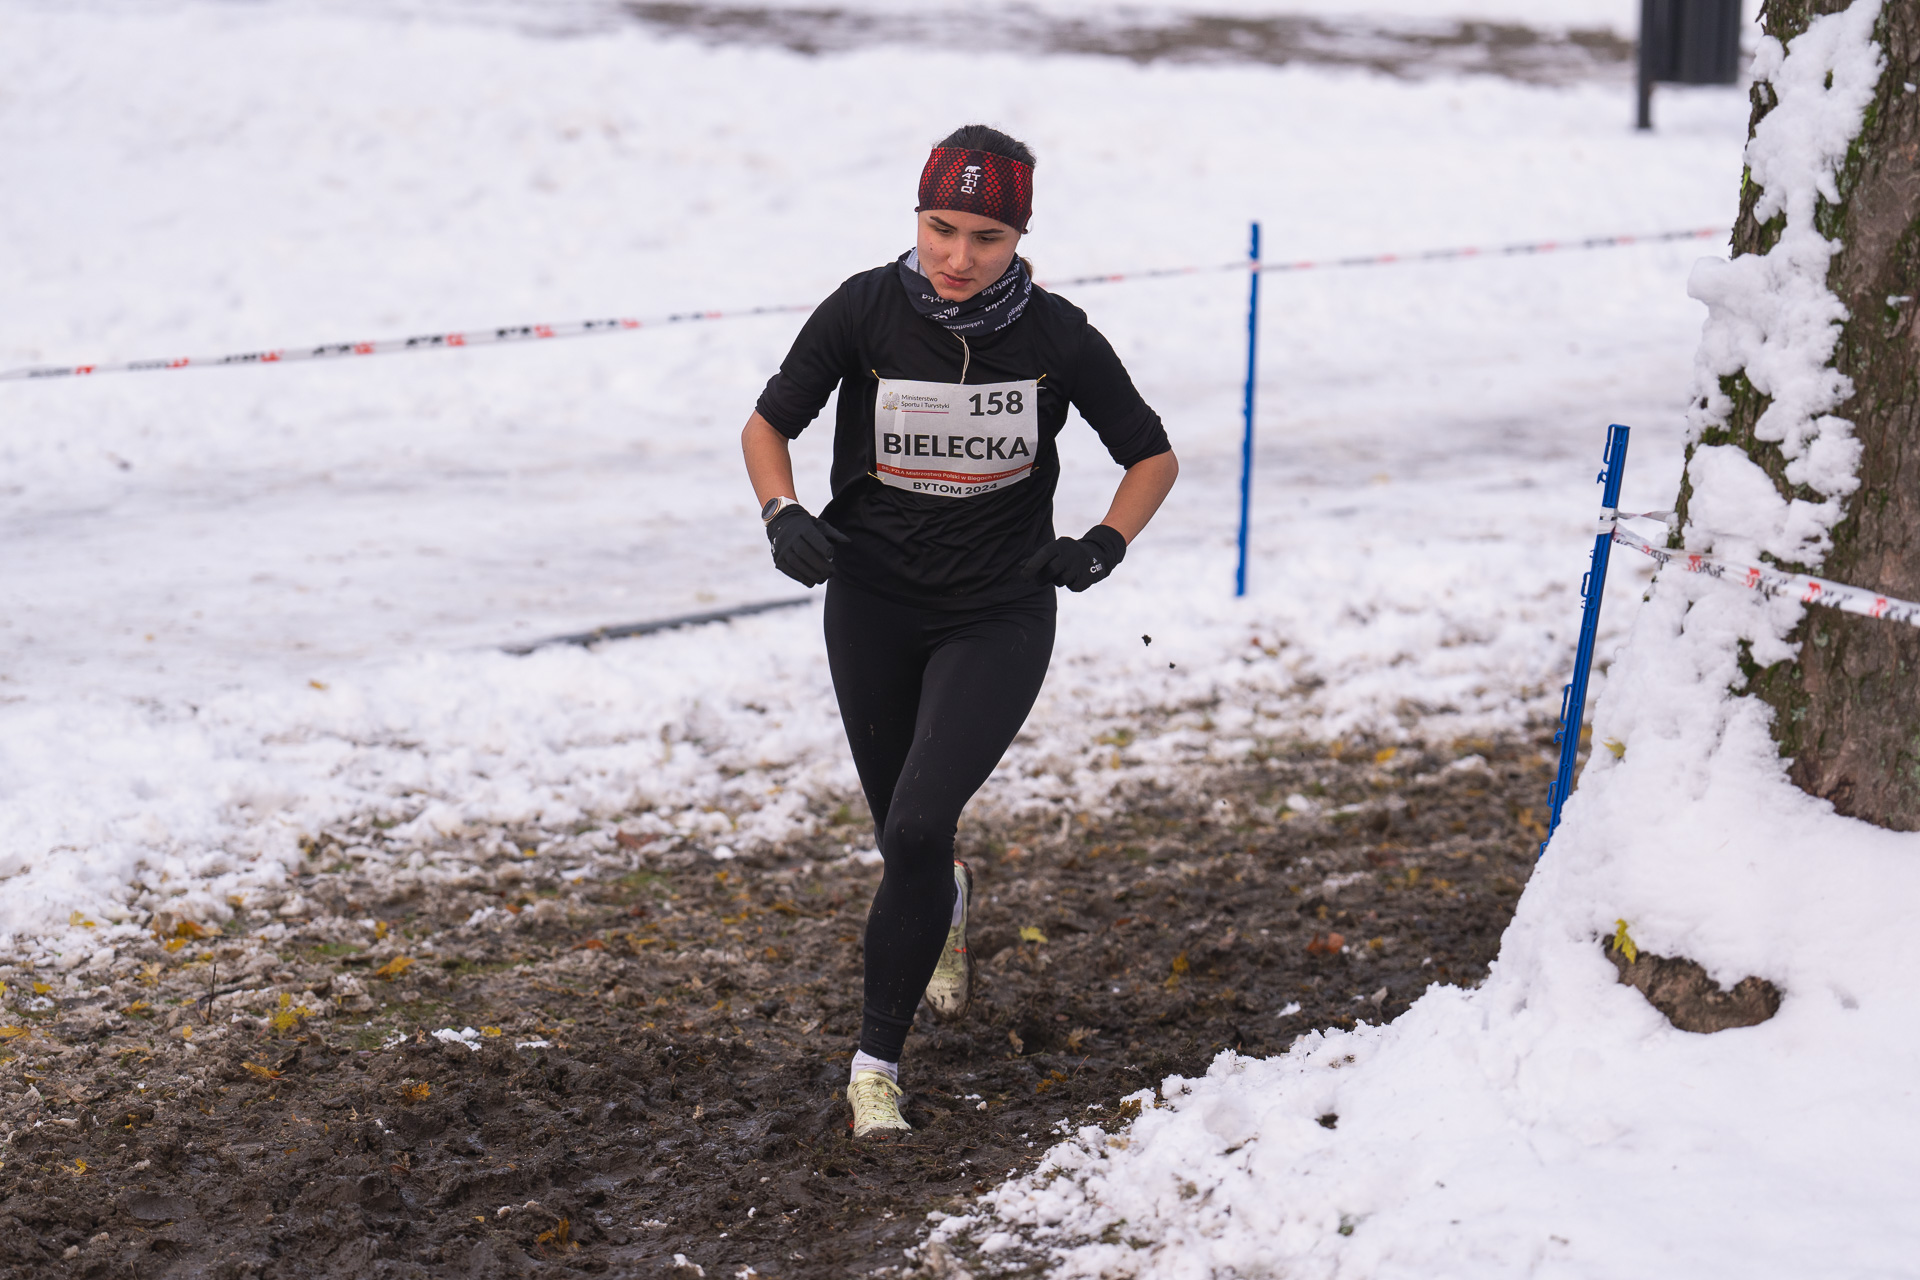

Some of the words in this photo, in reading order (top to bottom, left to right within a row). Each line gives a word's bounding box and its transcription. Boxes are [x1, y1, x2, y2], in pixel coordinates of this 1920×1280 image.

[901, 394, 938, 402] Ministerstwo
[901, 401, 920, 409] Sportu
[968, 390, 1024, 416] 158
[883, 433, 1030, 460] BIELECKA
[913, 481, 962, 495] BYTOM
[965, 482, 997, 495] 2024
